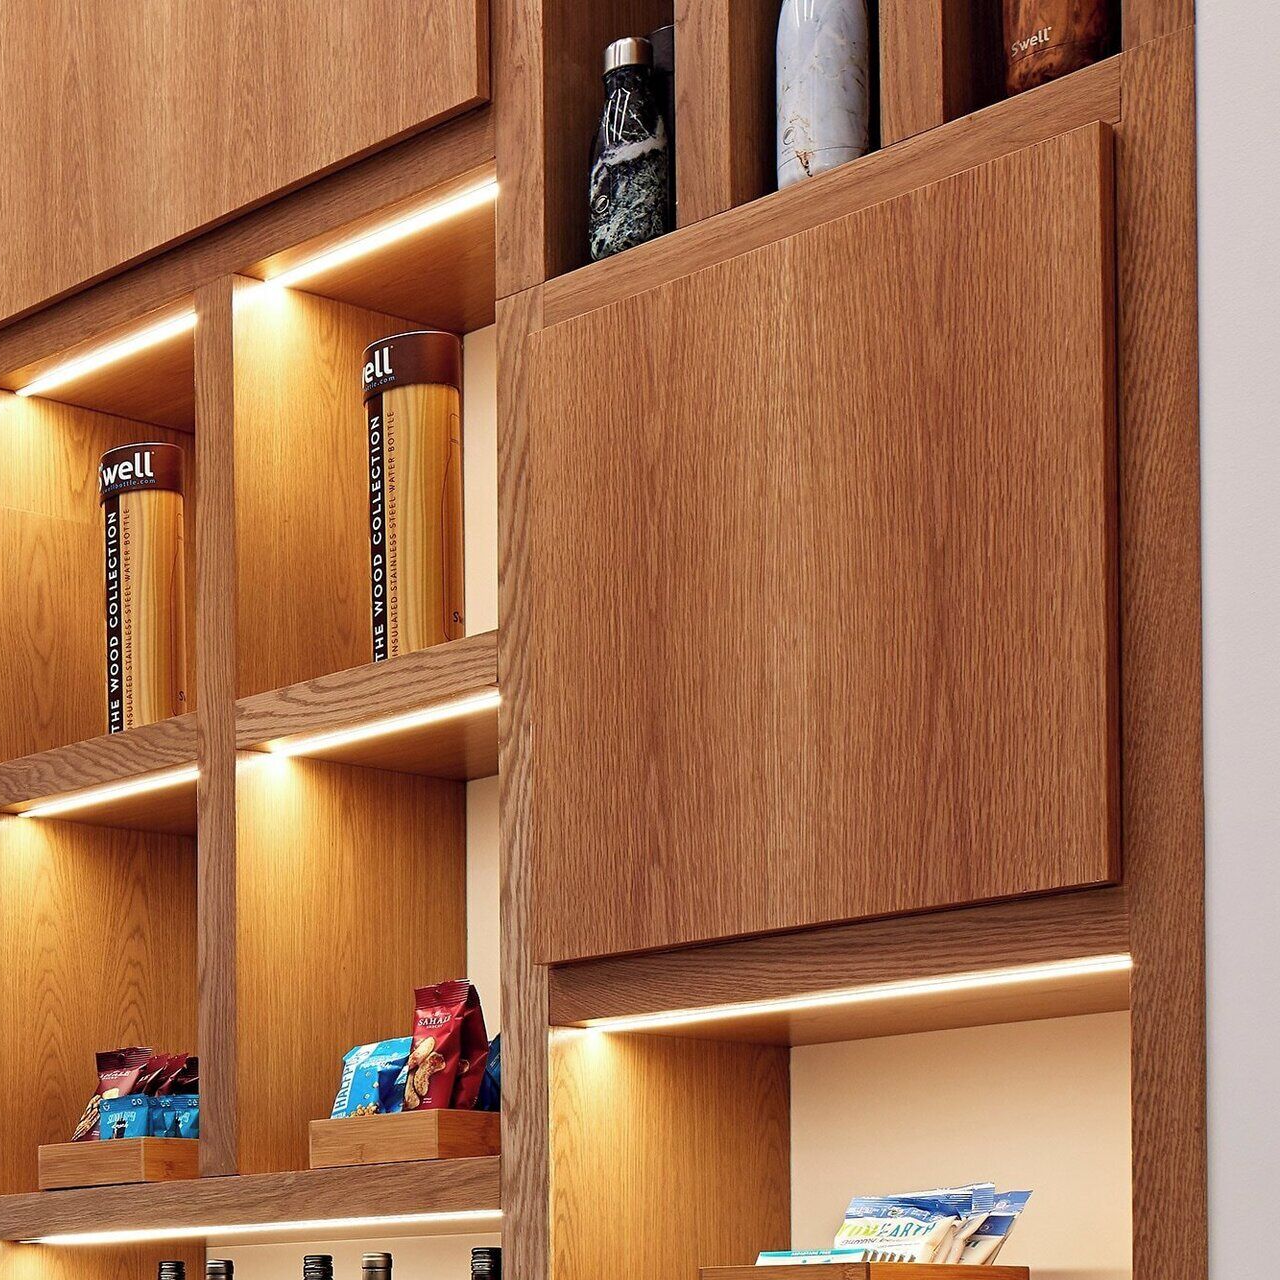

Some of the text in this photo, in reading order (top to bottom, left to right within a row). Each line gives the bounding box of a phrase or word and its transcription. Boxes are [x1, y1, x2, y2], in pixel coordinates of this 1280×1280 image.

[371, 415, 382, 545] COLLECTION
[388, 457, 396, 493] WATER
[108, 511, 120, 734] THE WOOD COLLECTION
[374, 554, 384, 662] THE WOOD
[391, 596, 399, 658] INSULATED
